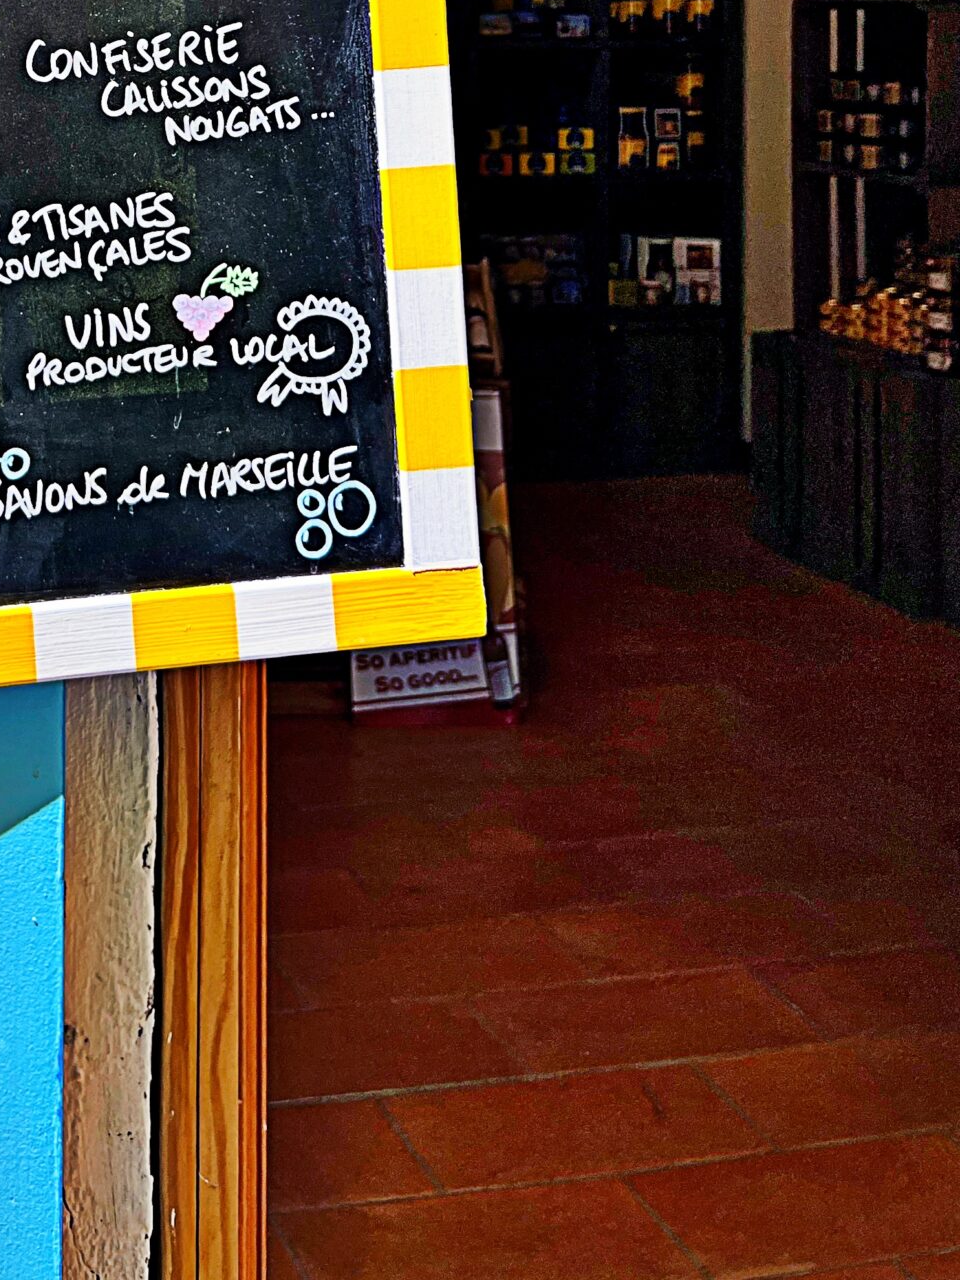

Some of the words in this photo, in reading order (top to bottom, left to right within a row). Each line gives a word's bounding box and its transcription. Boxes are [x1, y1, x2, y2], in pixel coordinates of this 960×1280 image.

[7, 210, 31, 247] &
[26, 344, 217, 391] PRODUCTEUR
[229, 332, 334, 365] LOCAL
[118, 466, 169, 505] de
[355, 653, 385, 671] SO
[374, 675, 404, 693] SO
